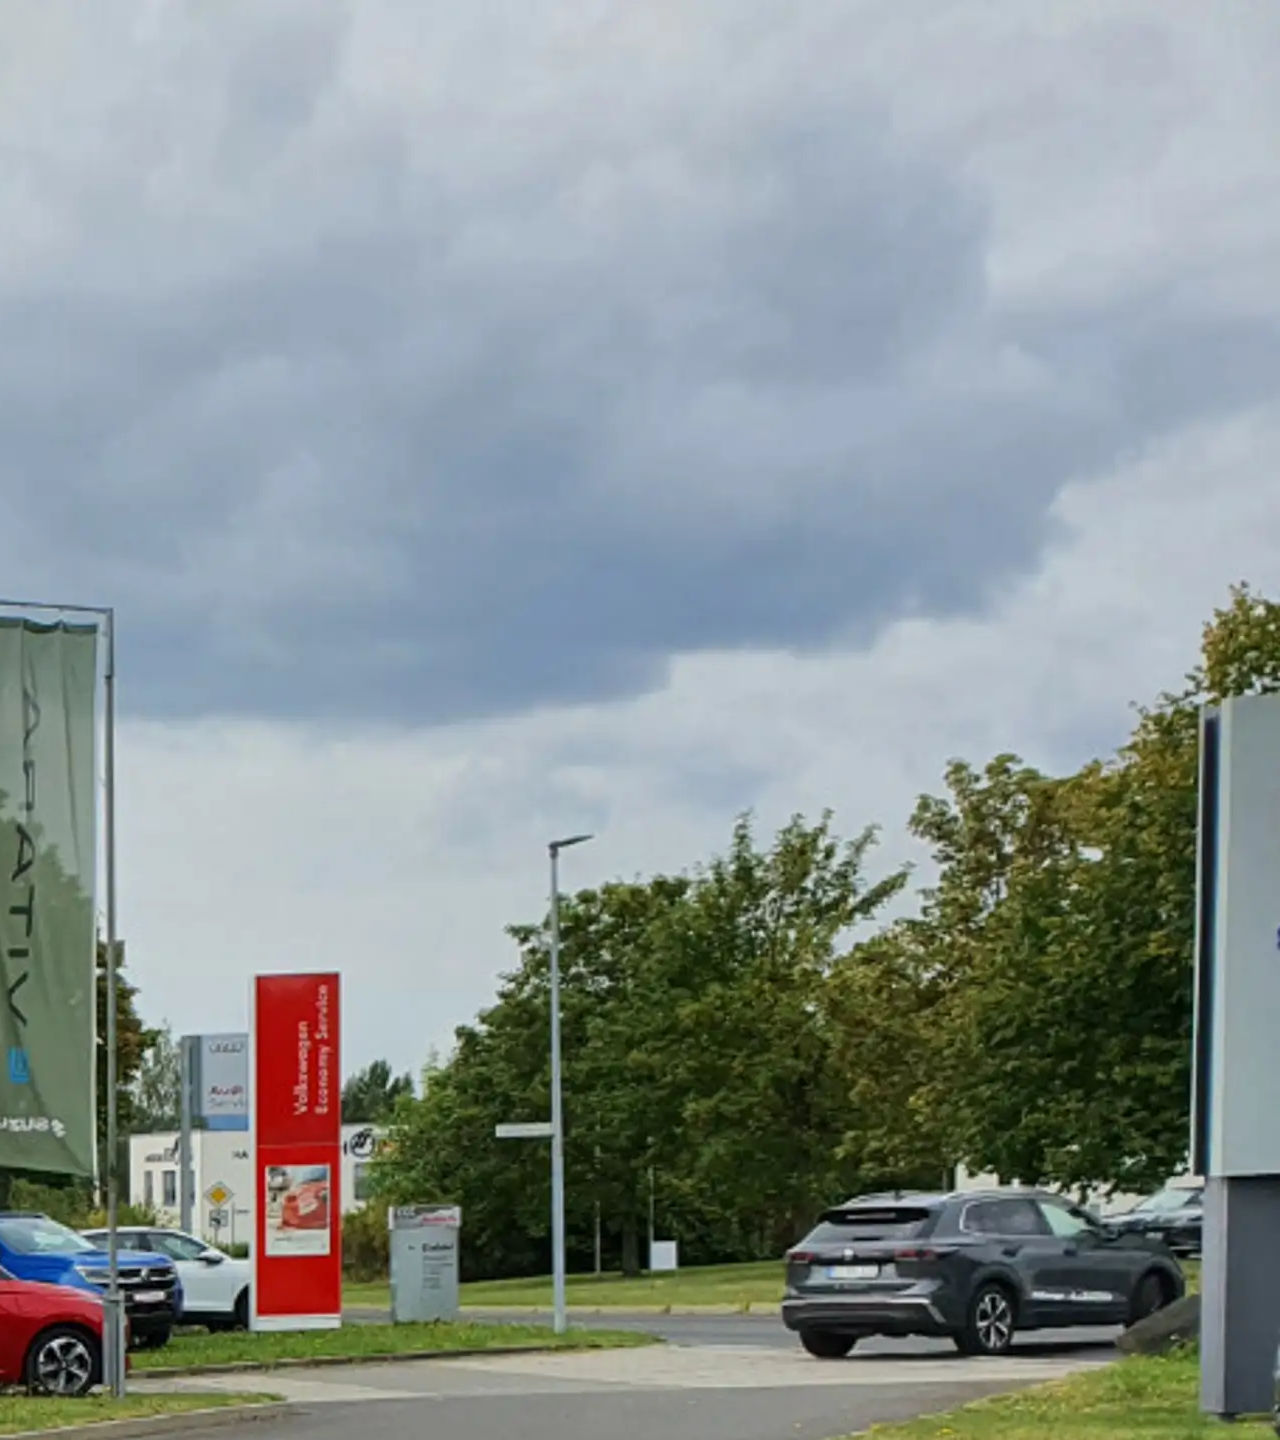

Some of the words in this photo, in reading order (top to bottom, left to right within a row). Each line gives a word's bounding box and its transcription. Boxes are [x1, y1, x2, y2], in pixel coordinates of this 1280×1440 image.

[314, 984, 329, 1040] Service
[293, 1020, 311, 1116] Volkswagen
[314, 1045, 332, 1114] Economy
